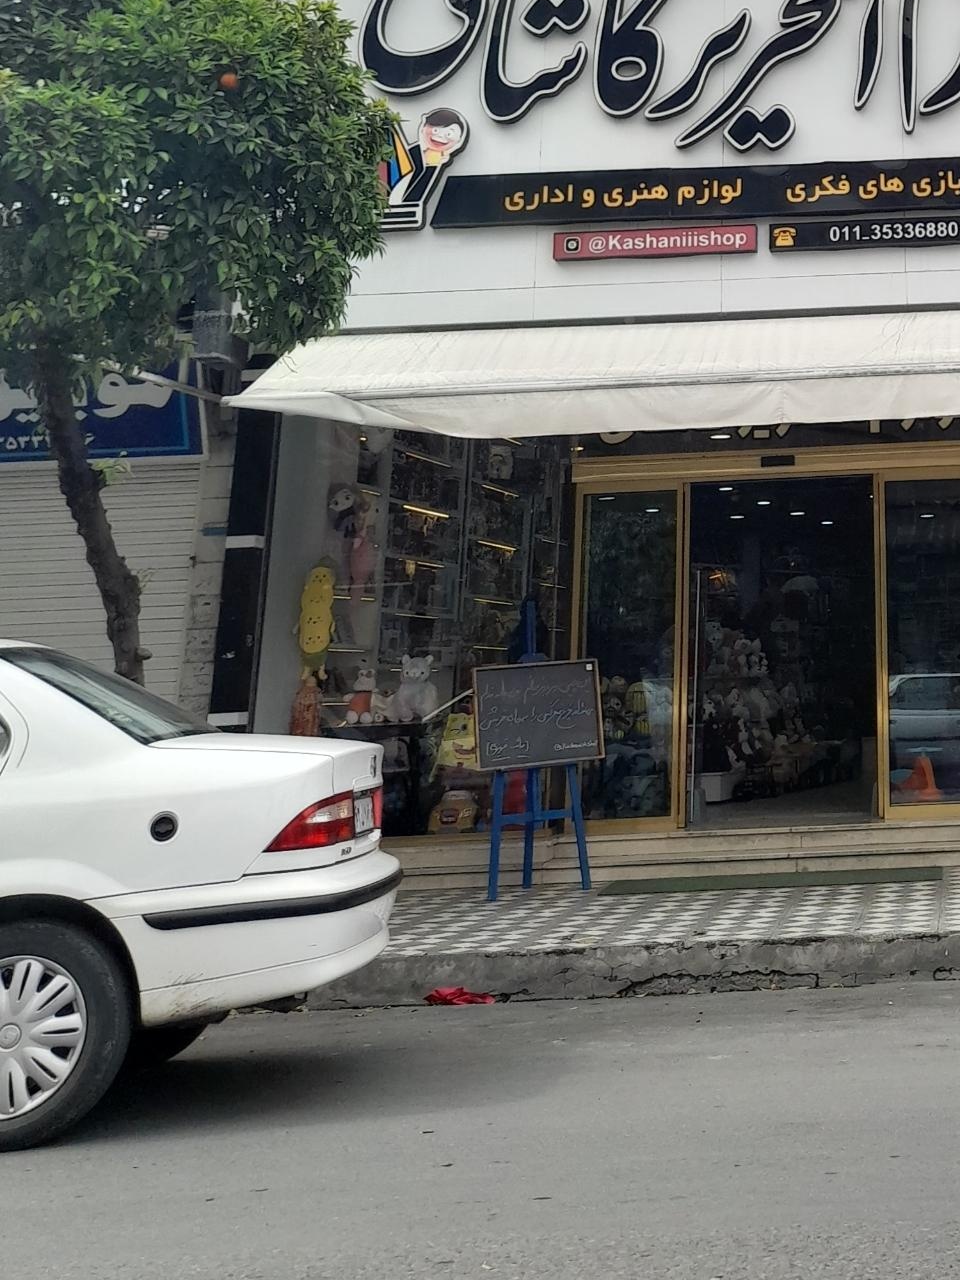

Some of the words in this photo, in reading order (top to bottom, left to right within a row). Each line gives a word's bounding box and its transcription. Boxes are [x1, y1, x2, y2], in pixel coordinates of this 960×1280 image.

[503, 183, 573, 211] اداری
[581, 188, 595, 208] و
[602, 182, 668, 208] هنری
[677, 177, 742, 205] لوازم
[786, 175, 850, 203] فکری
[858, 172, 905, 199] های
[588, 230, 747, 254] @Kashaniiishop
